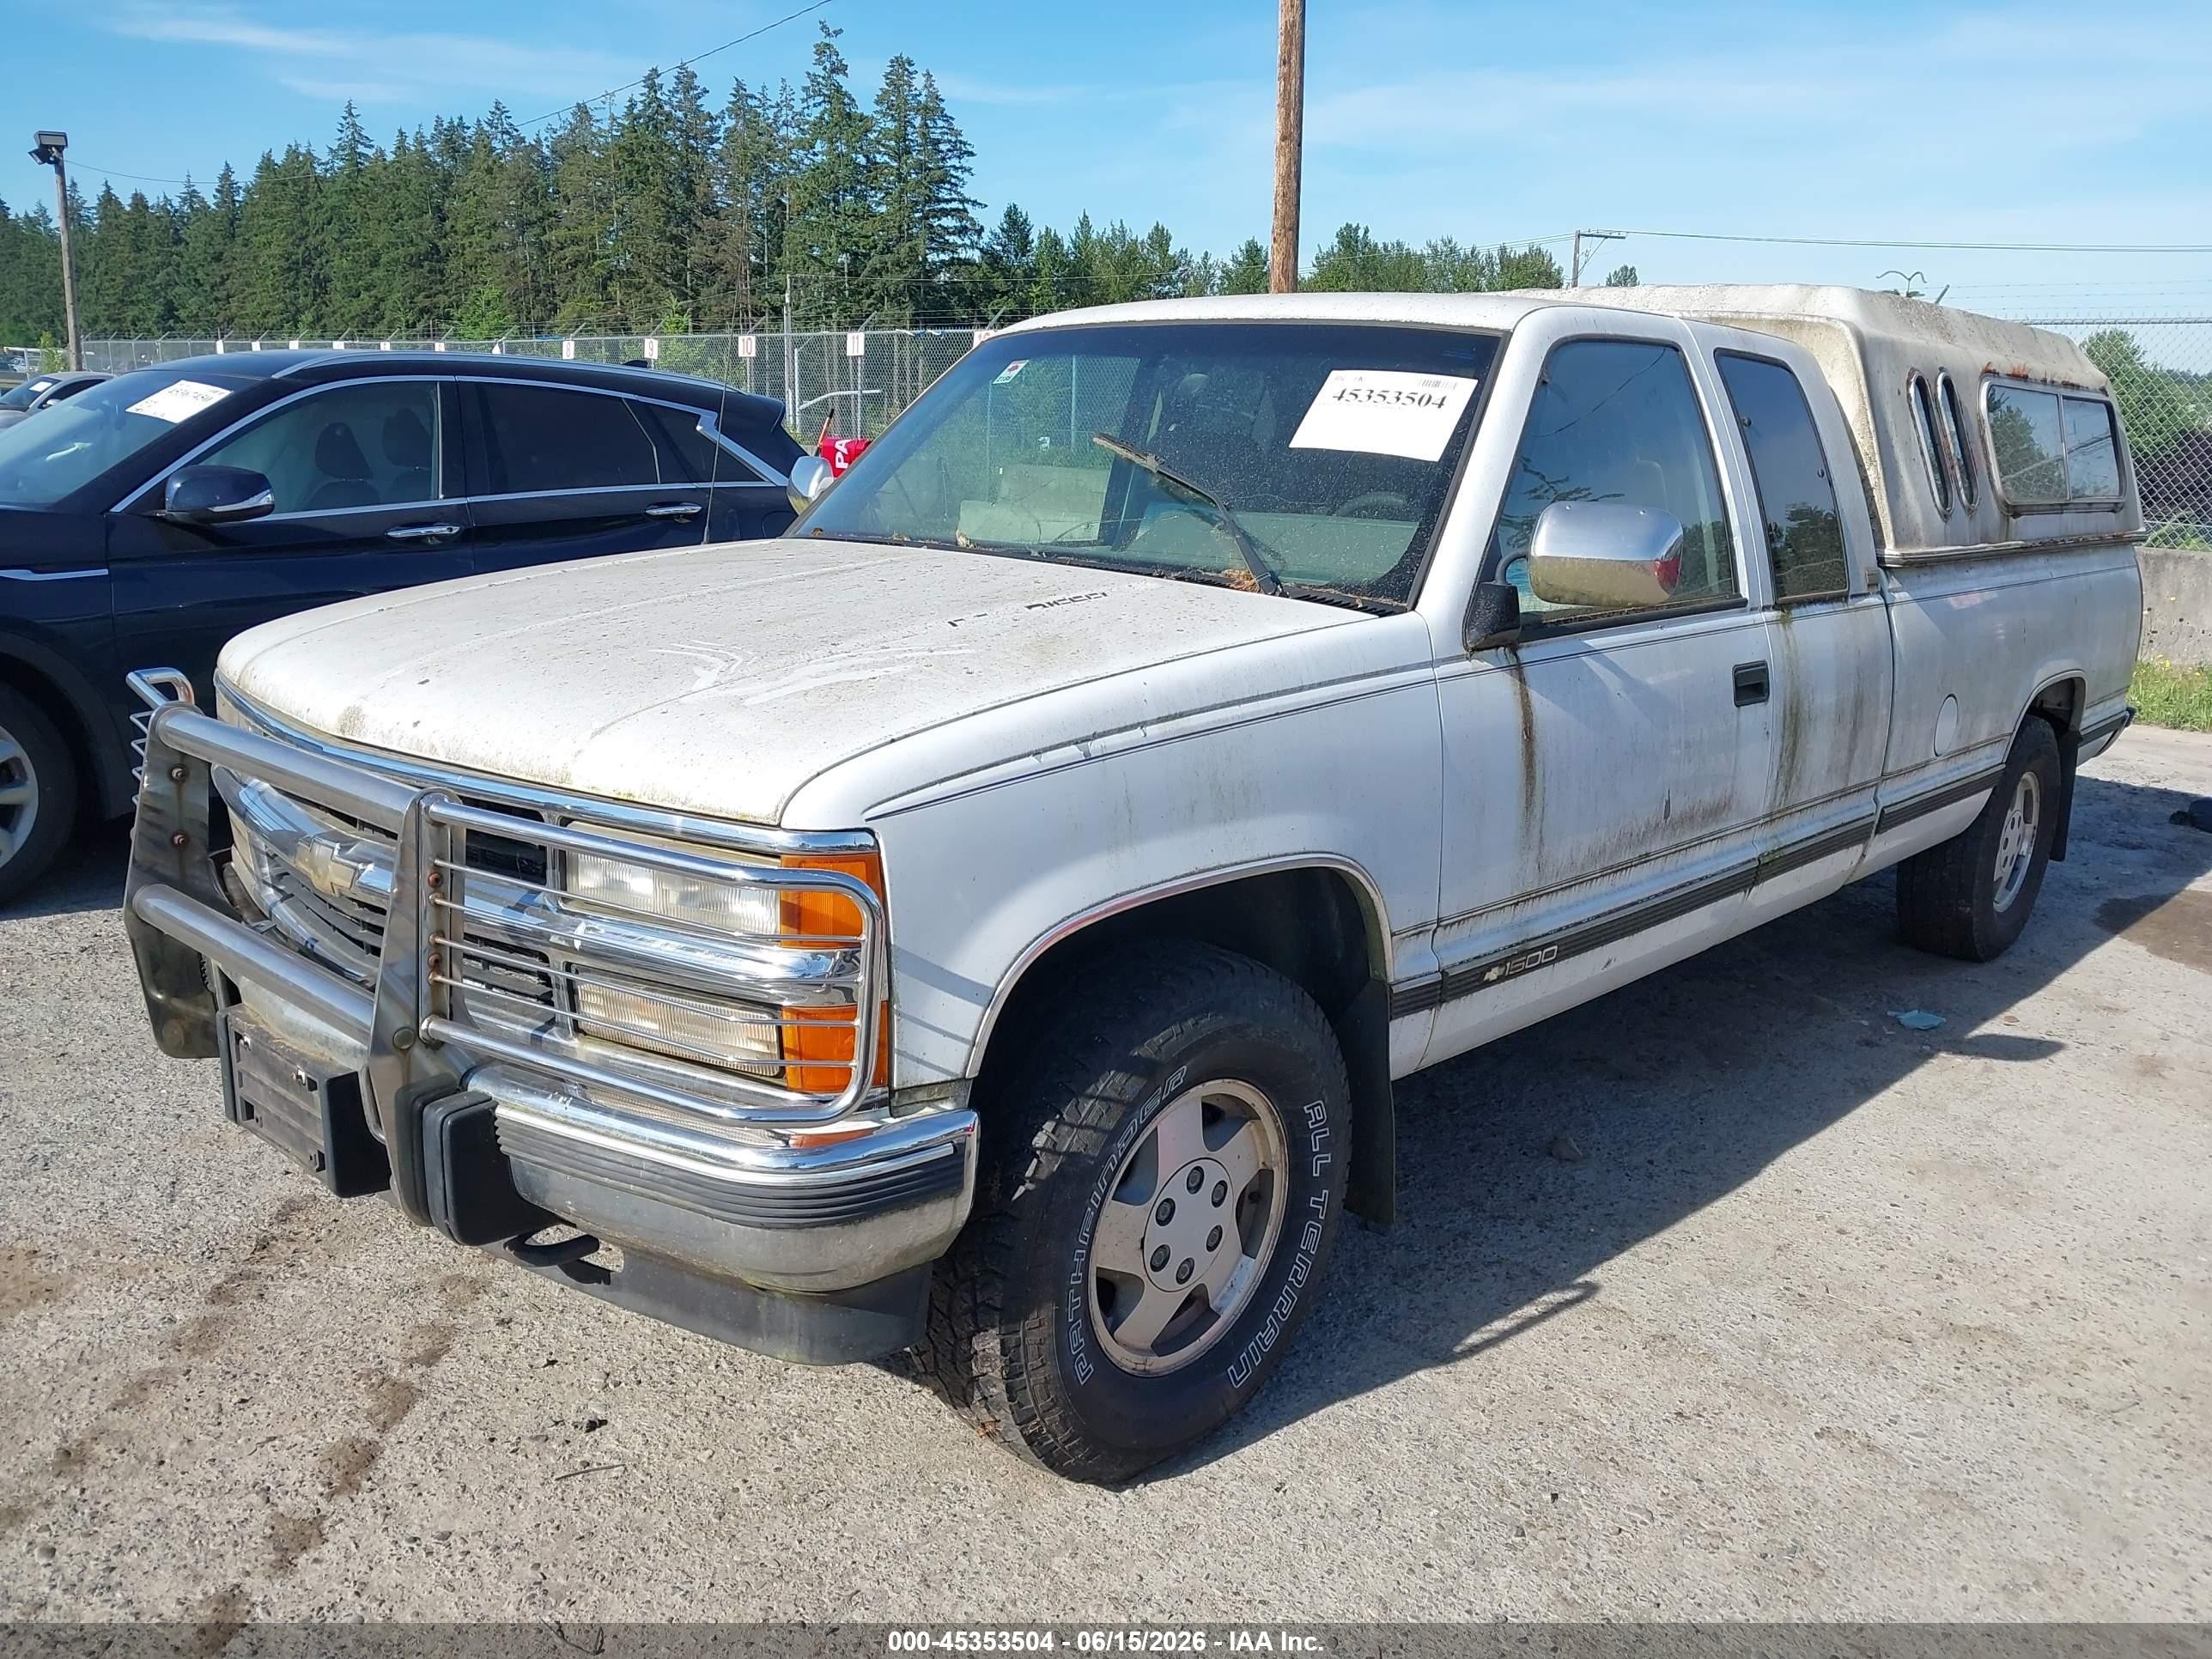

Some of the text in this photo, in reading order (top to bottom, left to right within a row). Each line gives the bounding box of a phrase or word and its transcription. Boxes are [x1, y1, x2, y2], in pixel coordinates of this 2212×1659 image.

[565, 341, 571, 358] 8
[648, 340, 654, 357] 9
[741, 337, 753, 356] 10
[851, 336, 860, 355] 11
[1332, 387, 1449, 410] 45353504
[1504, 945, 1559, 976] 1500
[1068, 1065, 1188, 1386] PATHFINDER
[1226, 1099, 1334, 1389] ALL TERRAIN
